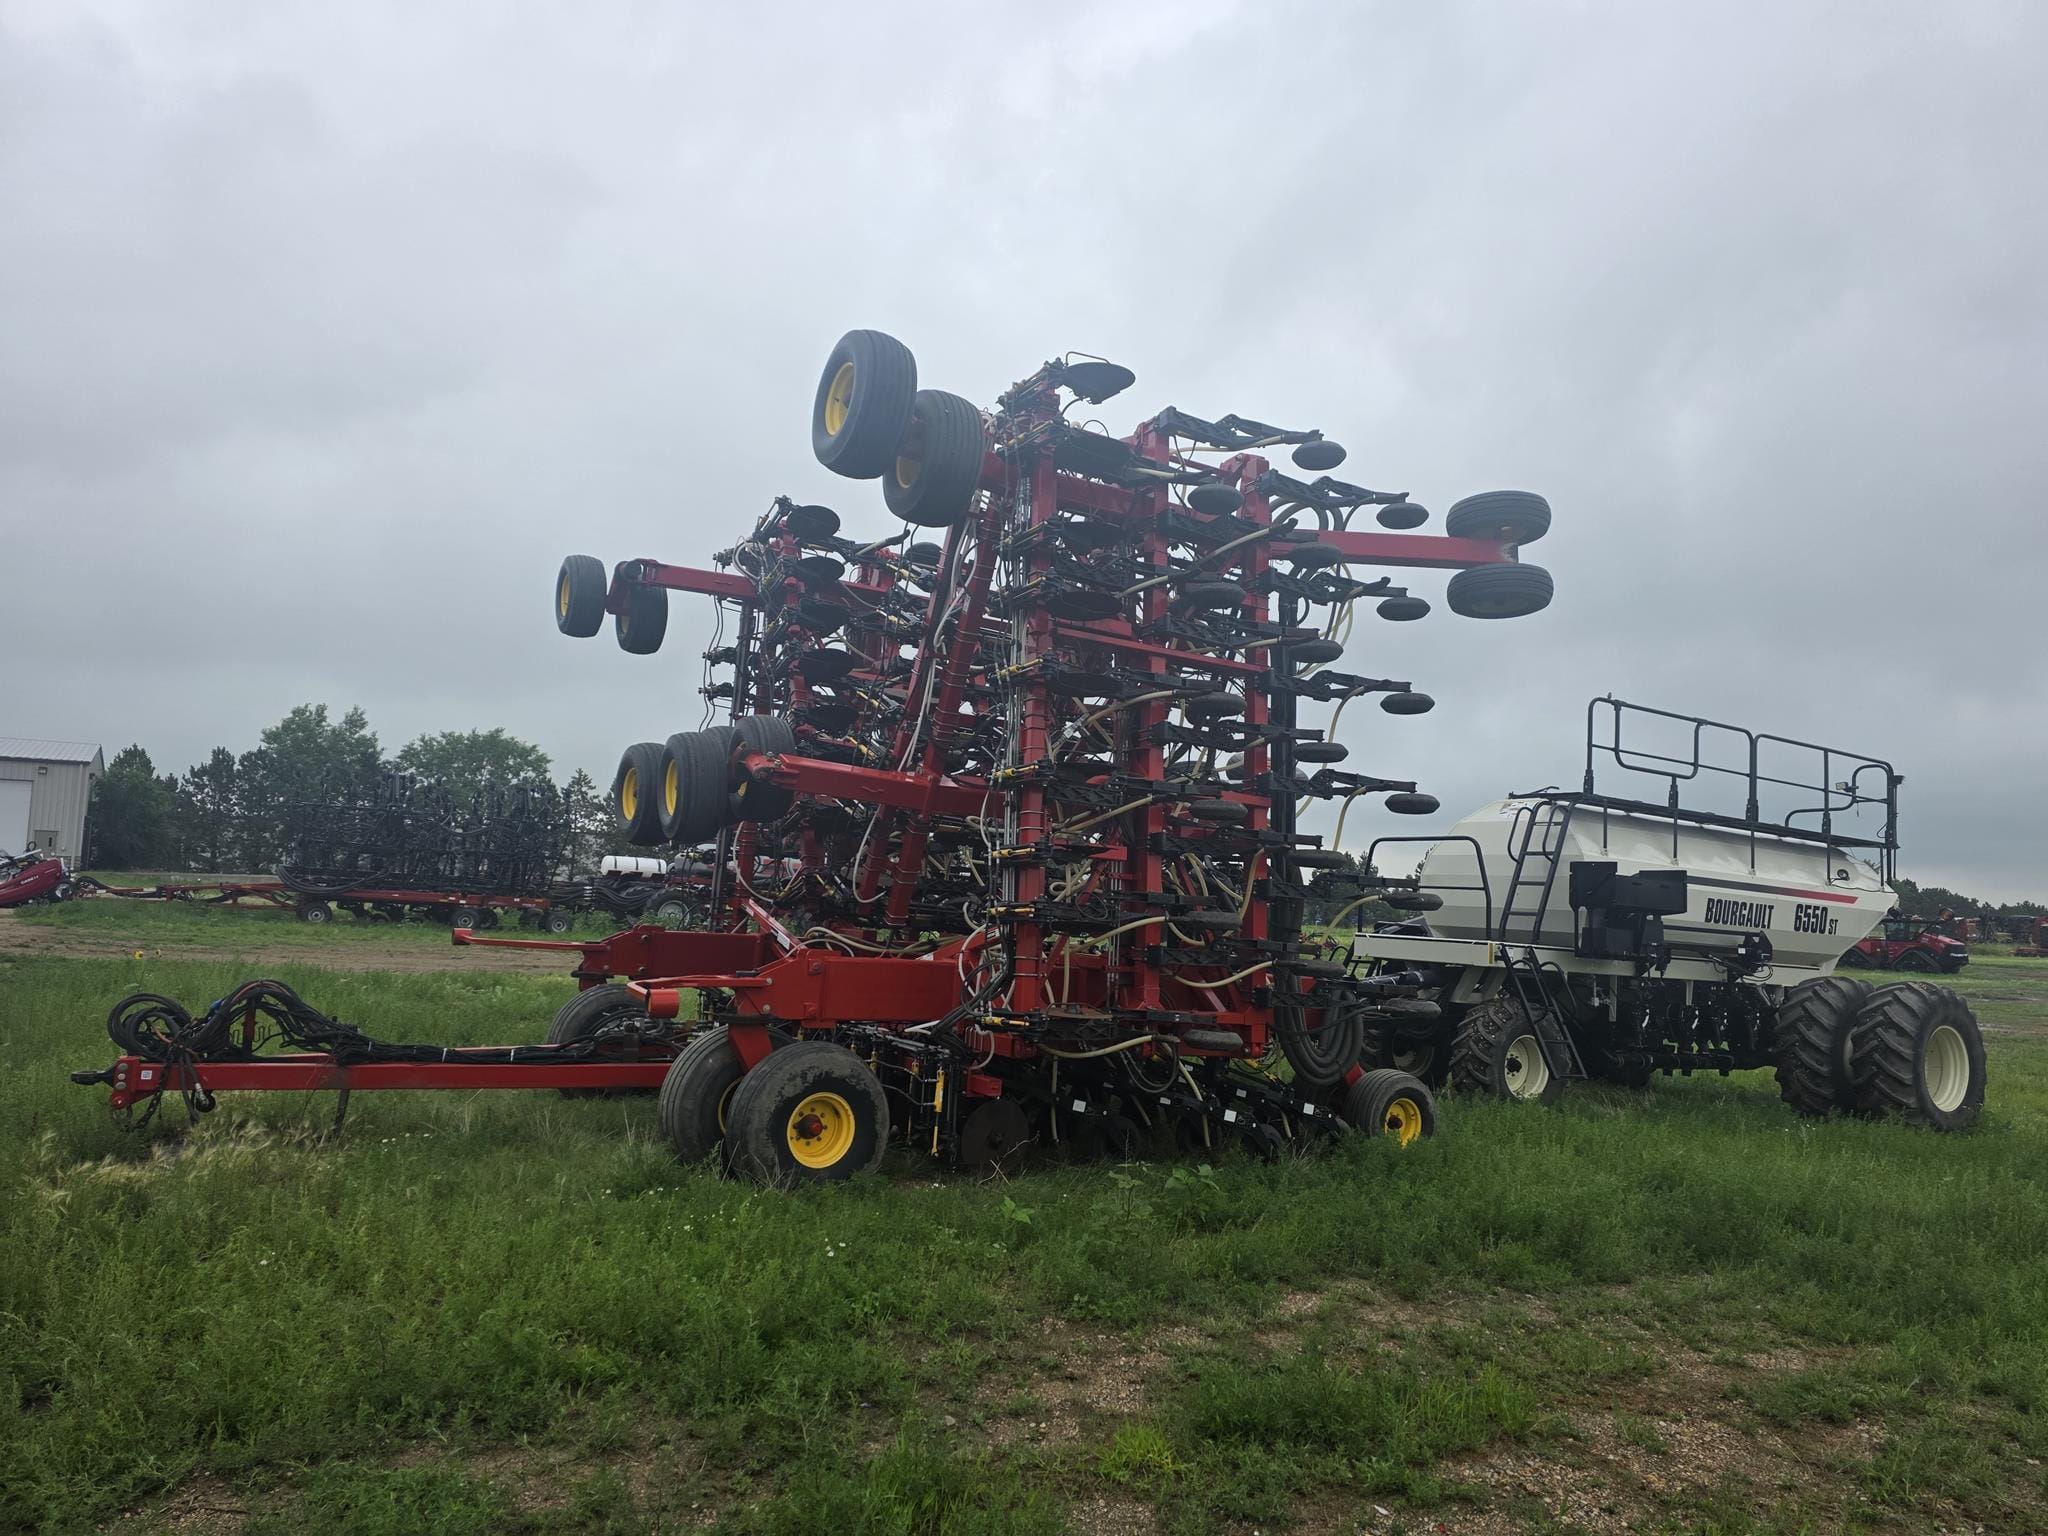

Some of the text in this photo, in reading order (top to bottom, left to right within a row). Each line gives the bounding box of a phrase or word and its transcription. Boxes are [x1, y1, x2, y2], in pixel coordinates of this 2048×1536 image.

[1705, 898, 1838, 935] BOURGAULT 6550 ST
